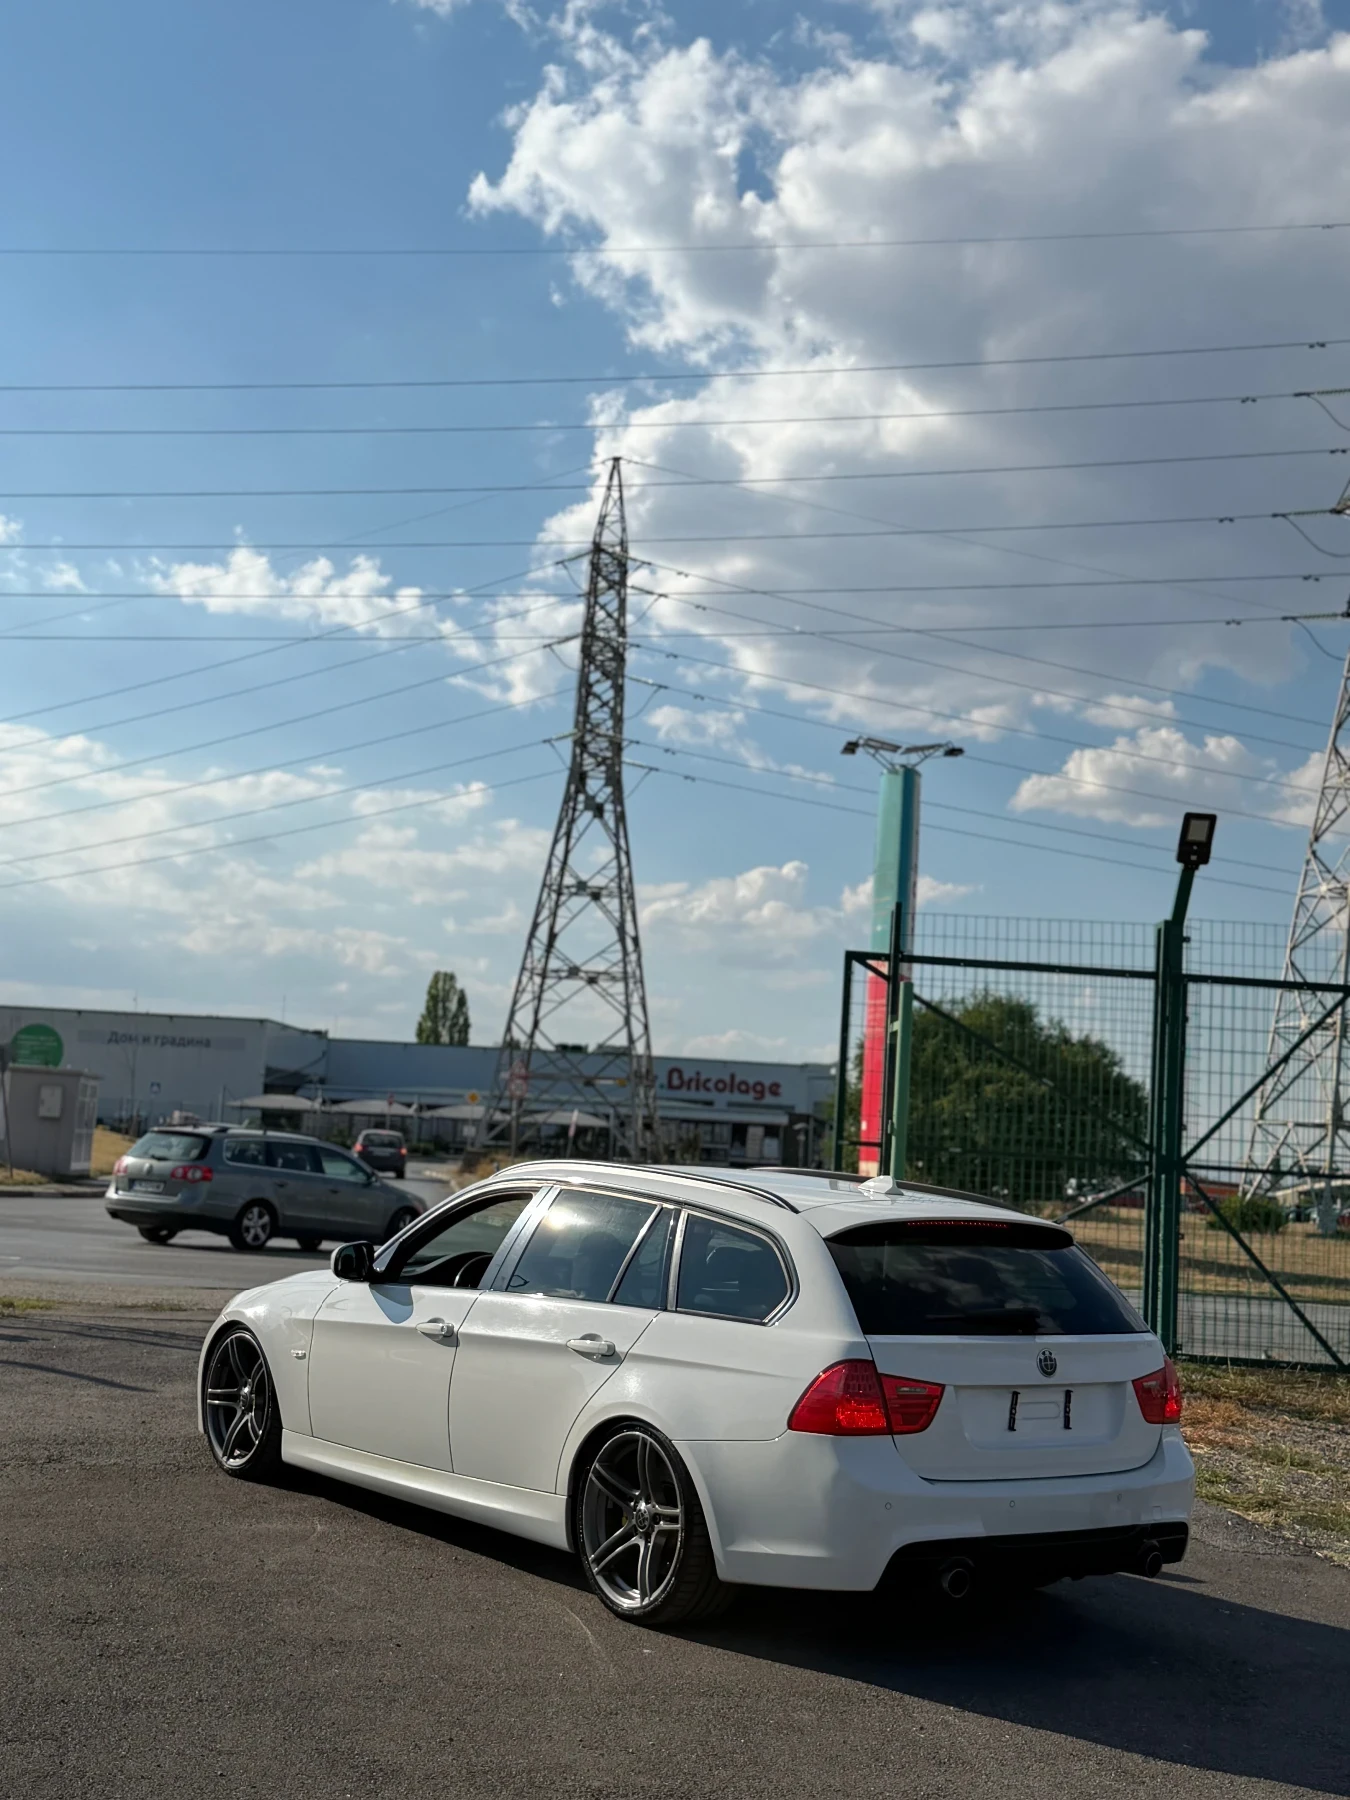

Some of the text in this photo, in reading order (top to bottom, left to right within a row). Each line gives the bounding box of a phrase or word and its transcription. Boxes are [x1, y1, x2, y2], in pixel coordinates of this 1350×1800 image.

[107, 1031, 212, 1048] Дом и градина
[667, 1067, 782, 1100] Bricolage
